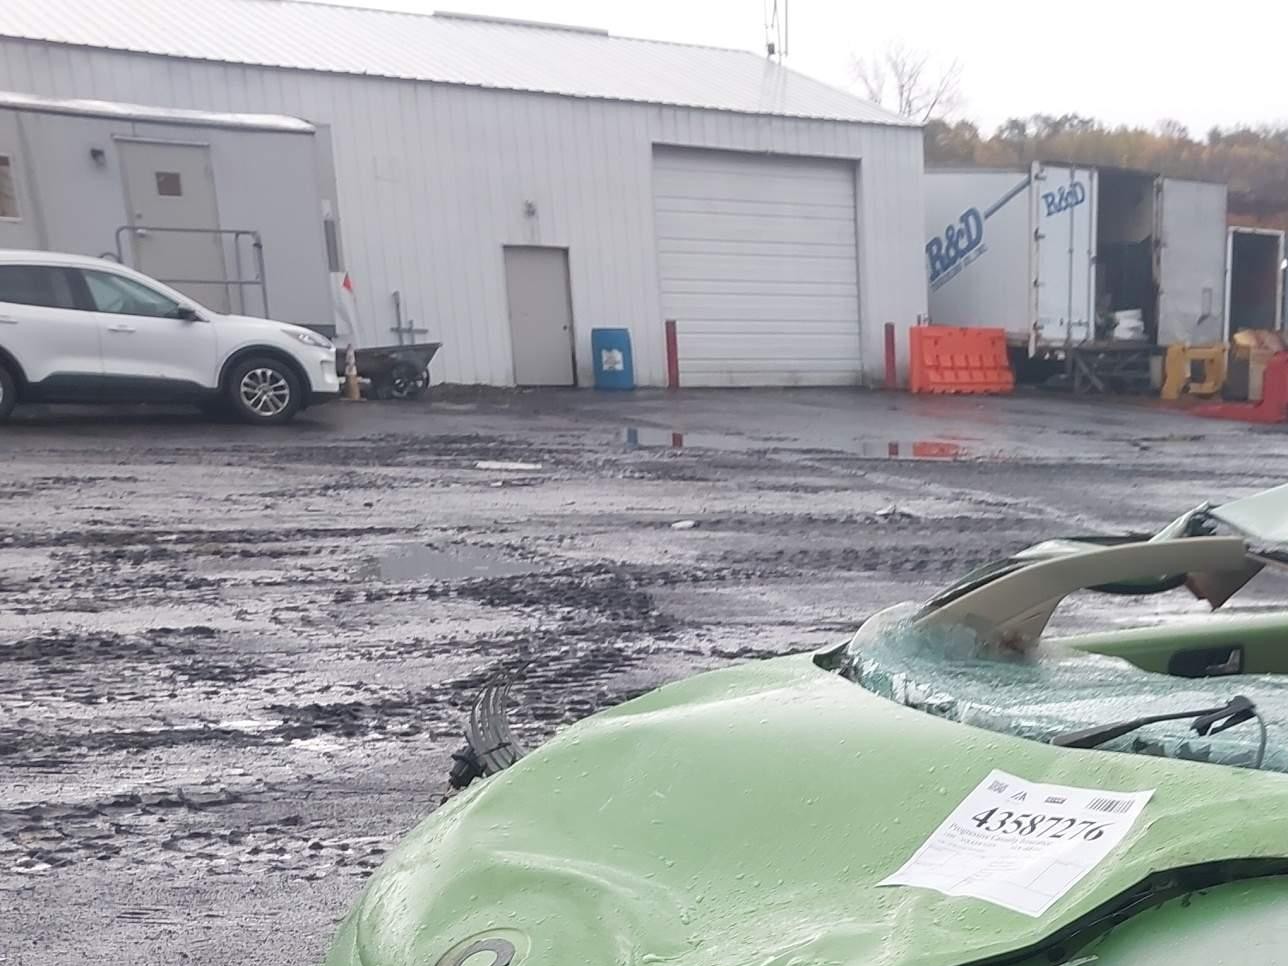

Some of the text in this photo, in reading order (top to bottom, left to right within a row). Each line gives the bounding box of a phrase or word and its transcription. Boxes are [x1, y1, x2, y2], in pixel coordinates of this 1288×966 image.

[1041, 181, 1085, 216] R&D
[925, 207, 983, 282] R&D
[972, 807, 1114, 841] 43587276
